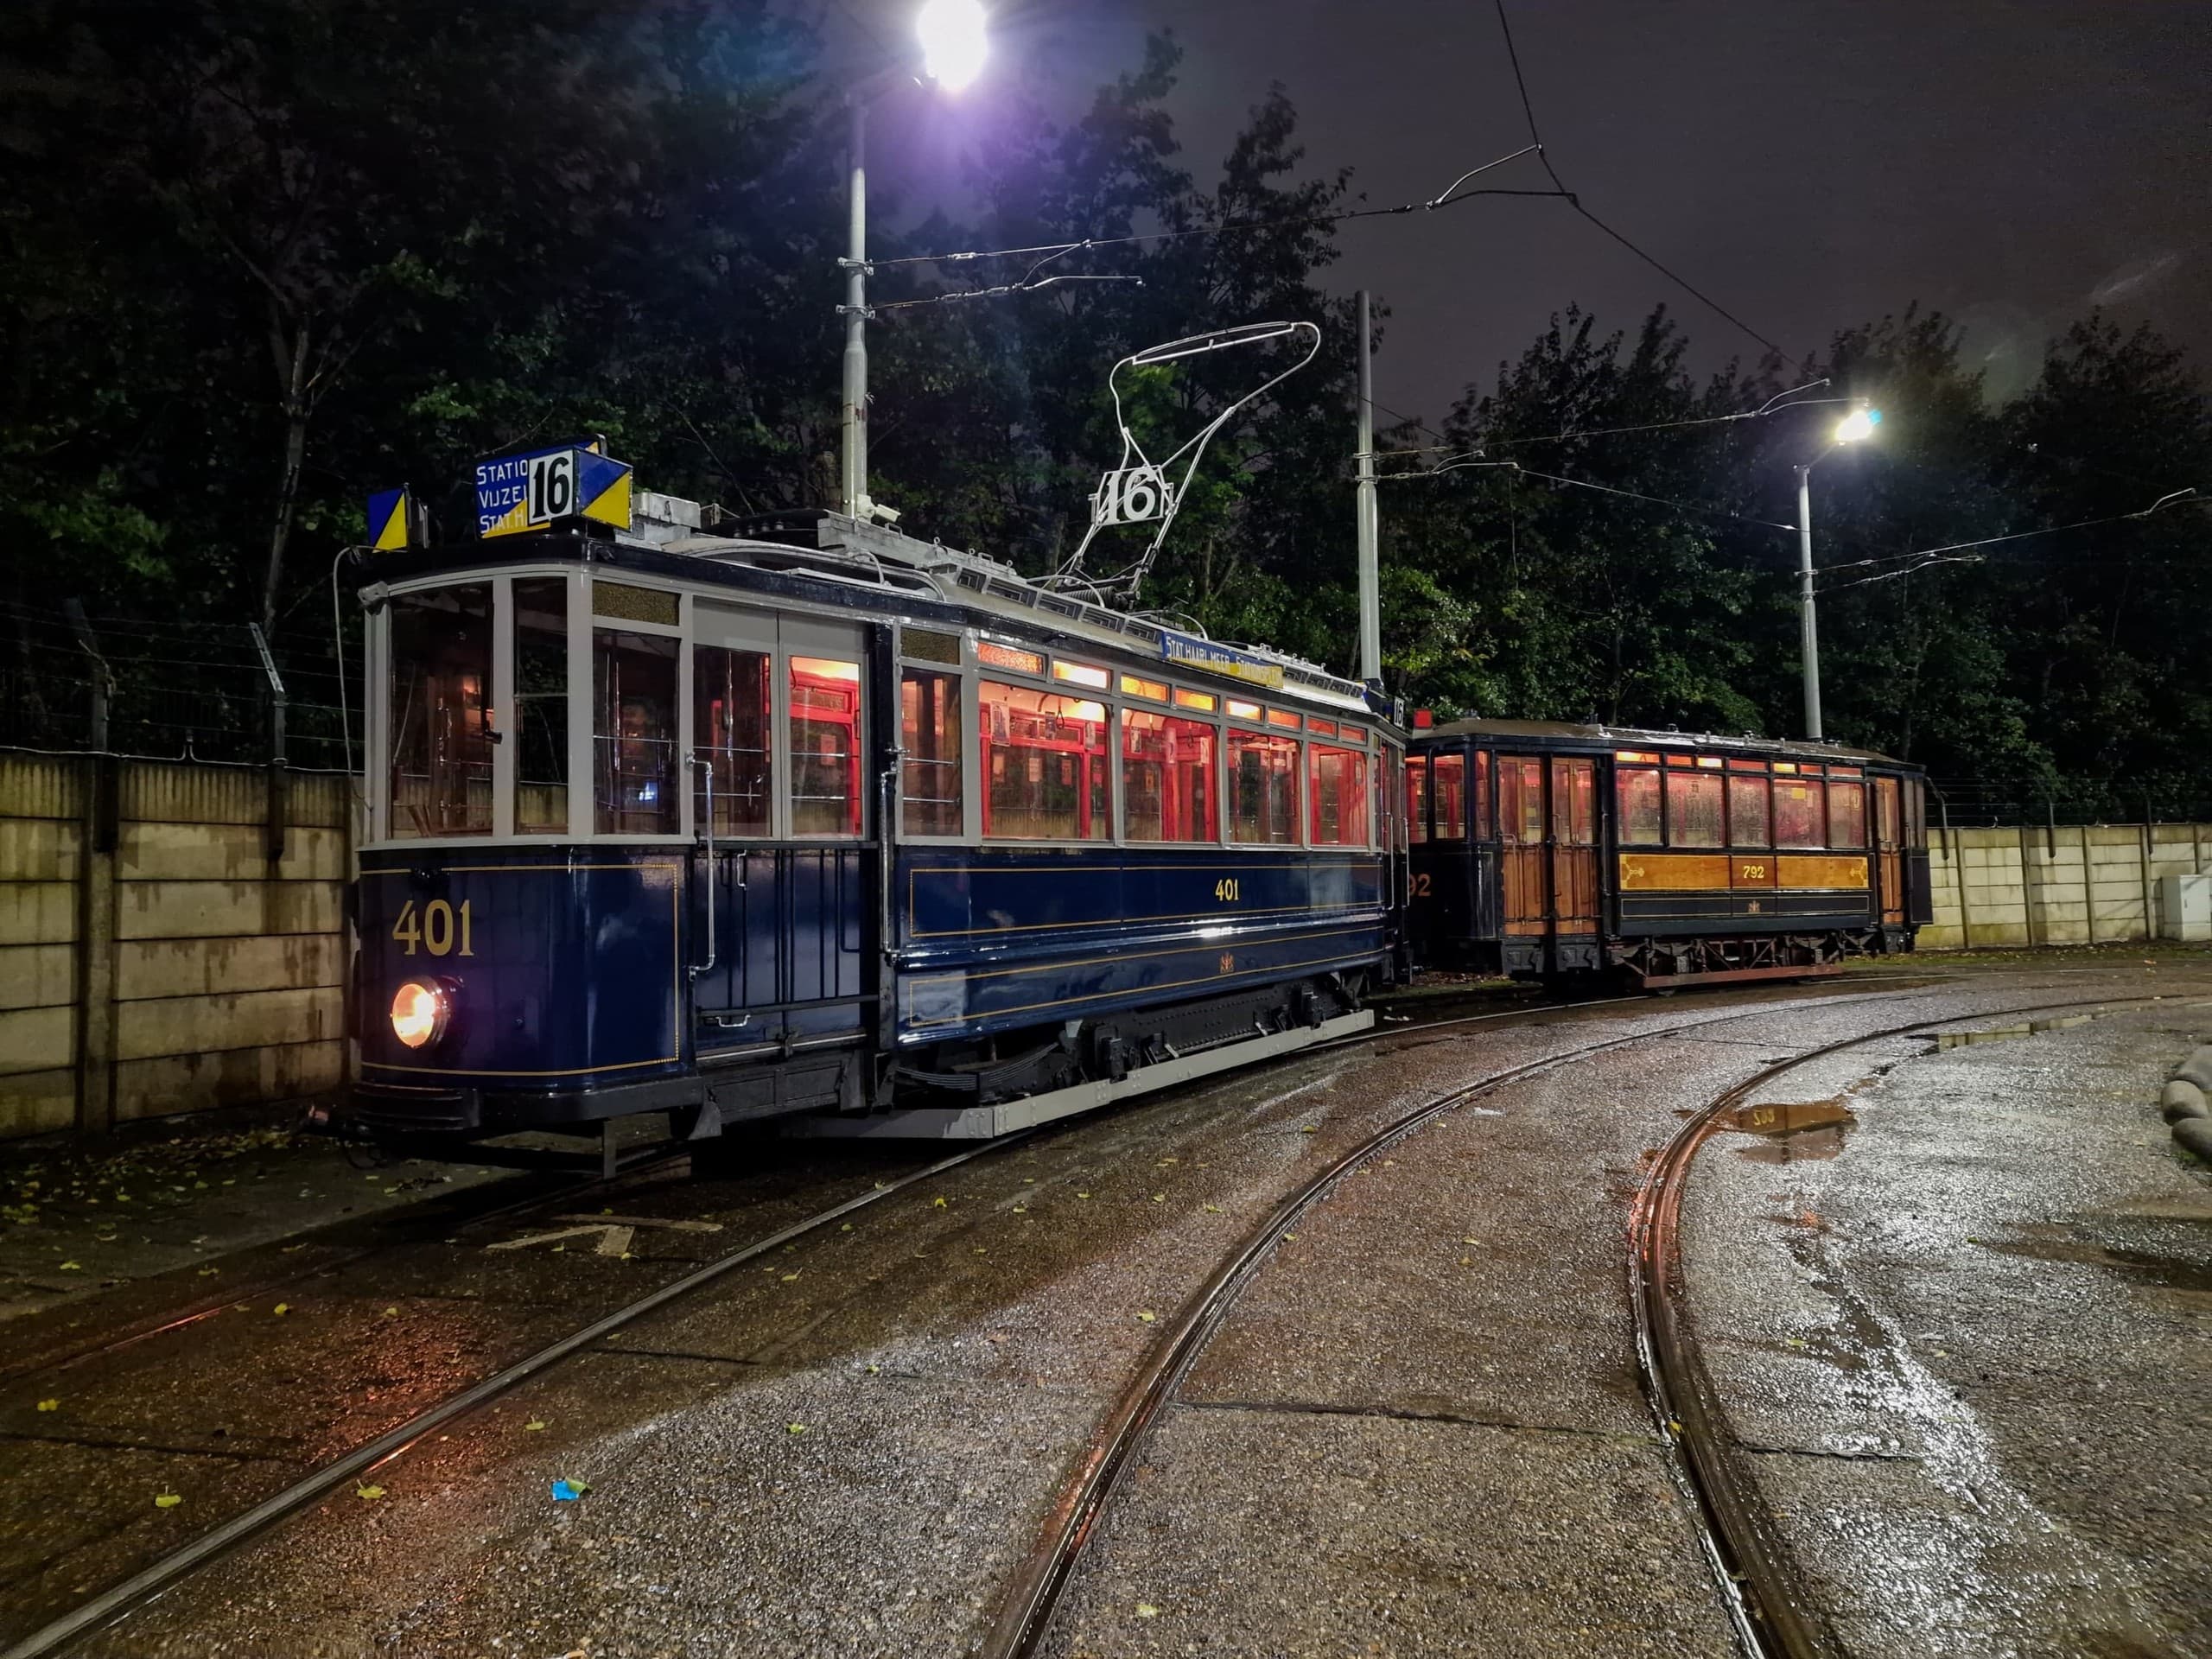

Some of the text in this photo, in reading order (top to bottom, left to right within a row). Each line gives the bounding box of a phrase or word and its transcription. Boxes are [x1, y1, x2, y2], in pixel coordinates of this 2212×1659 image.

[476, 459, 528, 486] STATIO
[531, 456, 570, 519] 16
[1104, 467, 1156, 525] 16
[1395, 700, 1403, 725] 16
[1742, 865, 1764, 879] 792
[1215, 878, 1239, 901] 401
[391, 899, 474, 957] 401
